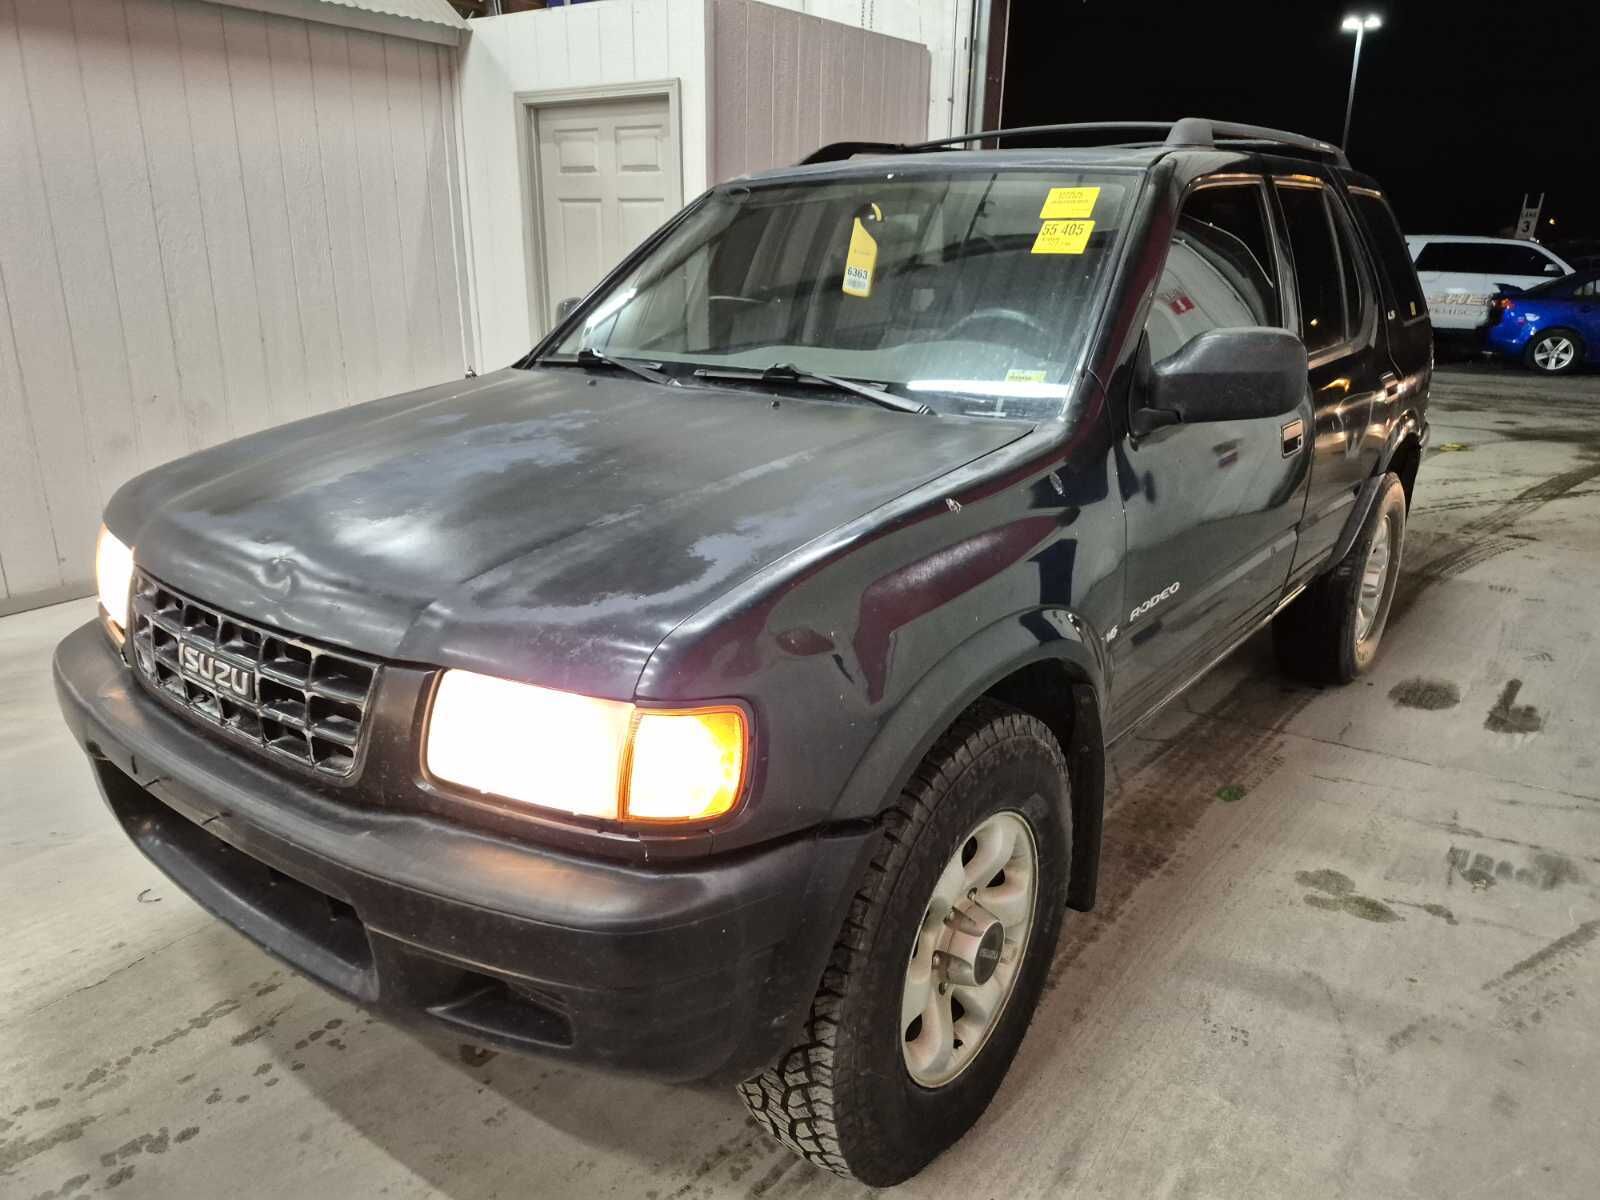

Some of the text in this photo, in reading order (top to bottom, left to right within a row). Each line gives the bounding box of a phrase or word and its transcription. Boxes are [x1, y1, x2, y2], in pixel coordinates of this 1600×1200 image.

[1041, 223, 1086, 237] 55 405
[1522, 220, 1530, 233] 3
[847, 266, 868, 280] 6363
[1129, 581, 1180, 622] RODEO
[178, 642, 249, 696] ISUZU
